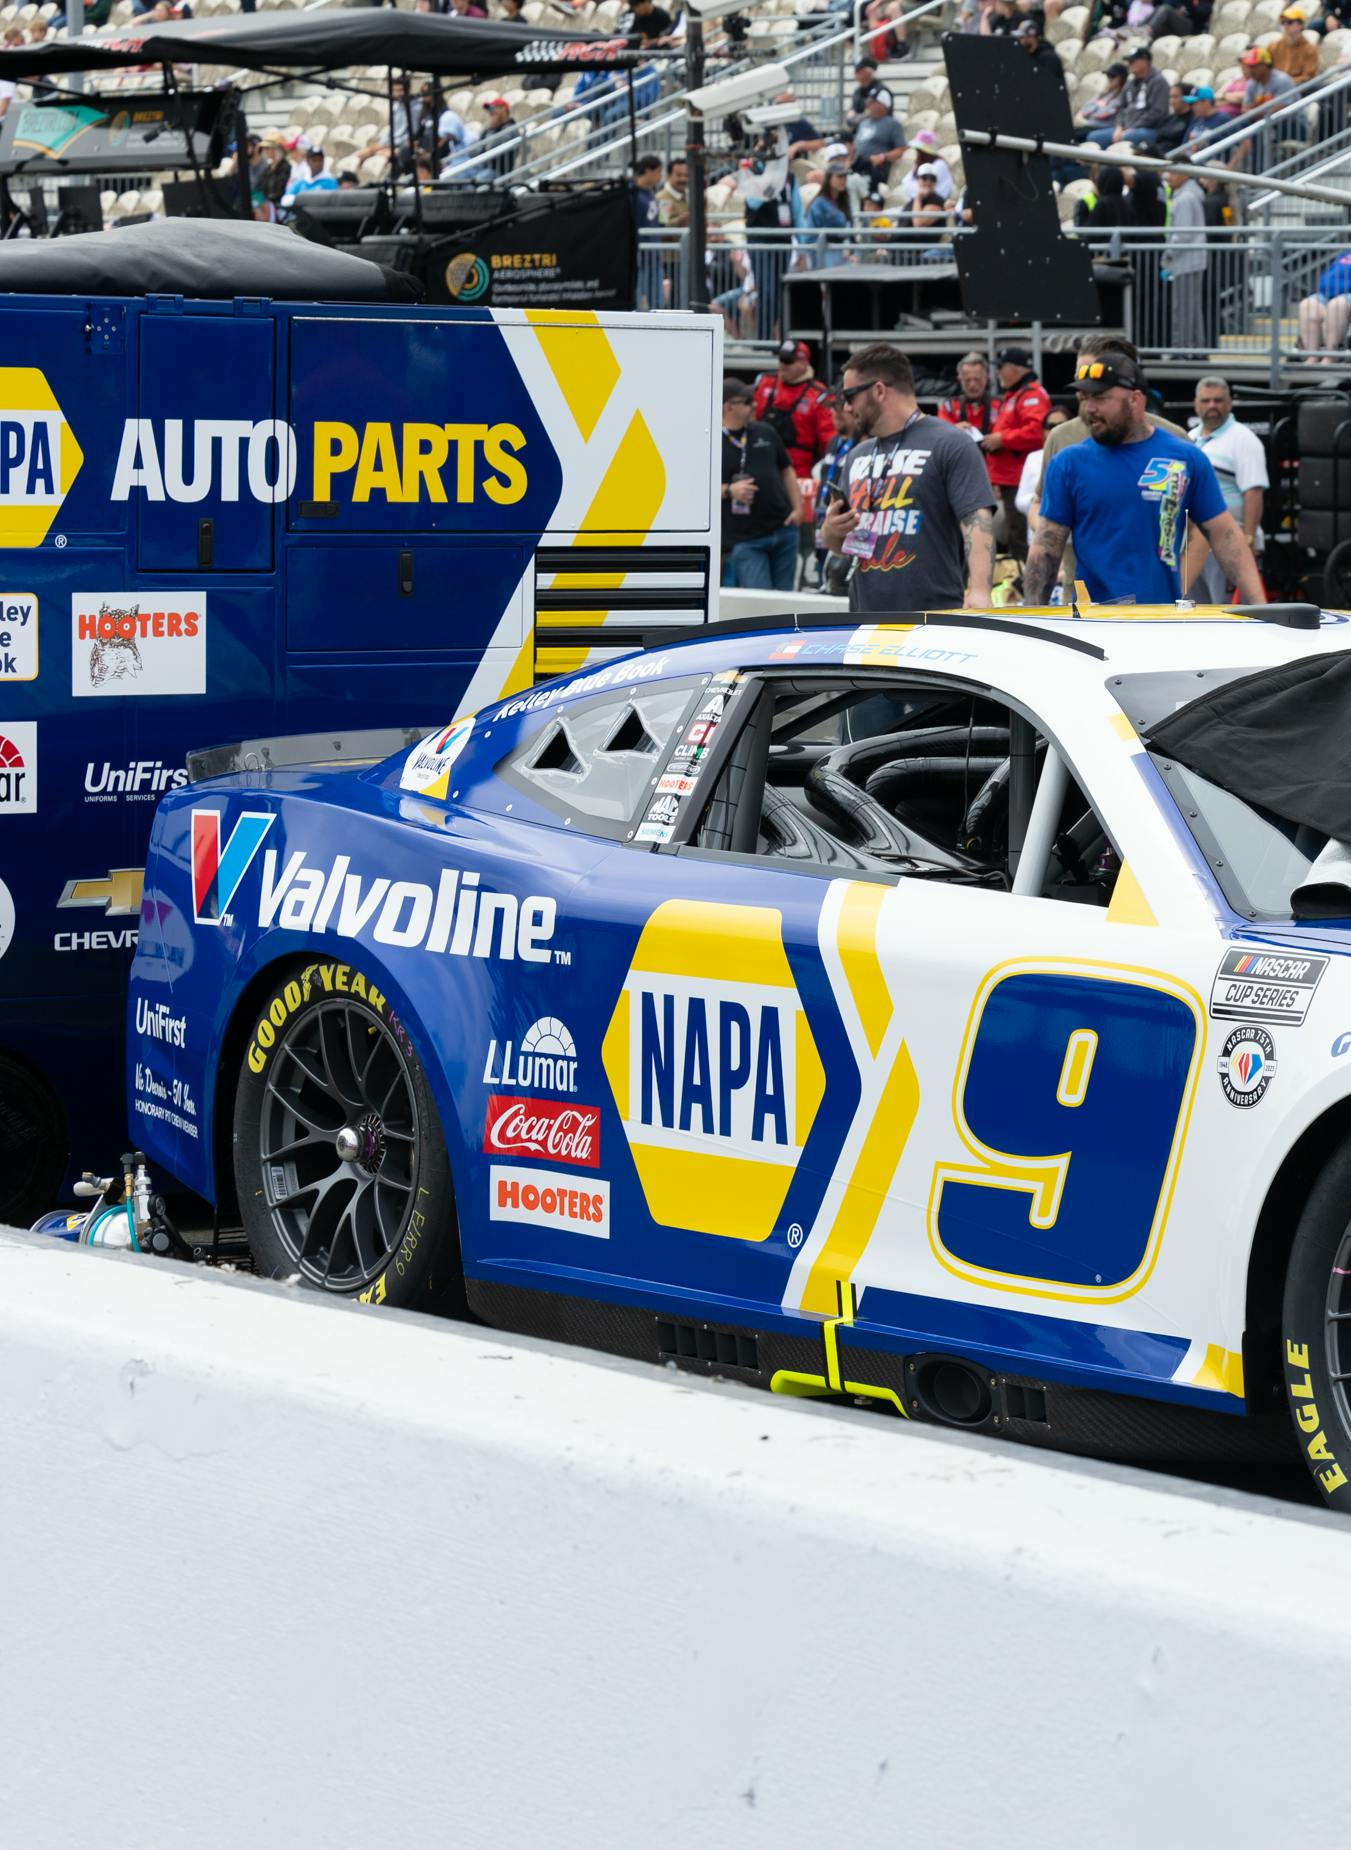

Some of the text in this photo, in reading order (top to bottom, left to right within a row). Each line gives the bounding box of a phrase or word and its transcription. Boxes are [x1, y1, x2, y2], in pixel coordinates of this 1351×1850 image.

[0, 420, 54, 495] PA
[110, 418, 528, 505] AUTO PARTS
[1137, 457, 1173, 486] 5
[78, 611, 199, 640] HOOTERS
[800, 643, 978, 664] CHASE ELLIOTT
[492, 655, 671, 723] Kelley Blue Book
[84, 761, 188, 793] UniFirs
[84, 793, 156, 803] UNIFORMS SERVICES
[258, 849, 557, 964] Valvoline
[54, 930, 139, 951] CHEVR
[1251, 956, 1311, 981] NASCAR
[1225, 983, 1299, 1008] CUP SERIES
[135, 997, 186, 1049] UniFirst
[1226, 1028, 1273, 1055] NASCAR 75TH
[482, 1039, 578, 1093] LLumar
[641, 991, 788, 1146] NAPA
[134, 1098, 165, 1120] HONORARY
[1222, 1076, 1267, 1106] ANNIVERSARY
[490, 1104, 598, 1160] Coca-Cola
[926, 955, 1208, 1306] 9
[497, 1180, 604, 1223] HOOTERS
[1286, 1338, 1349, 1495] EAGLE
